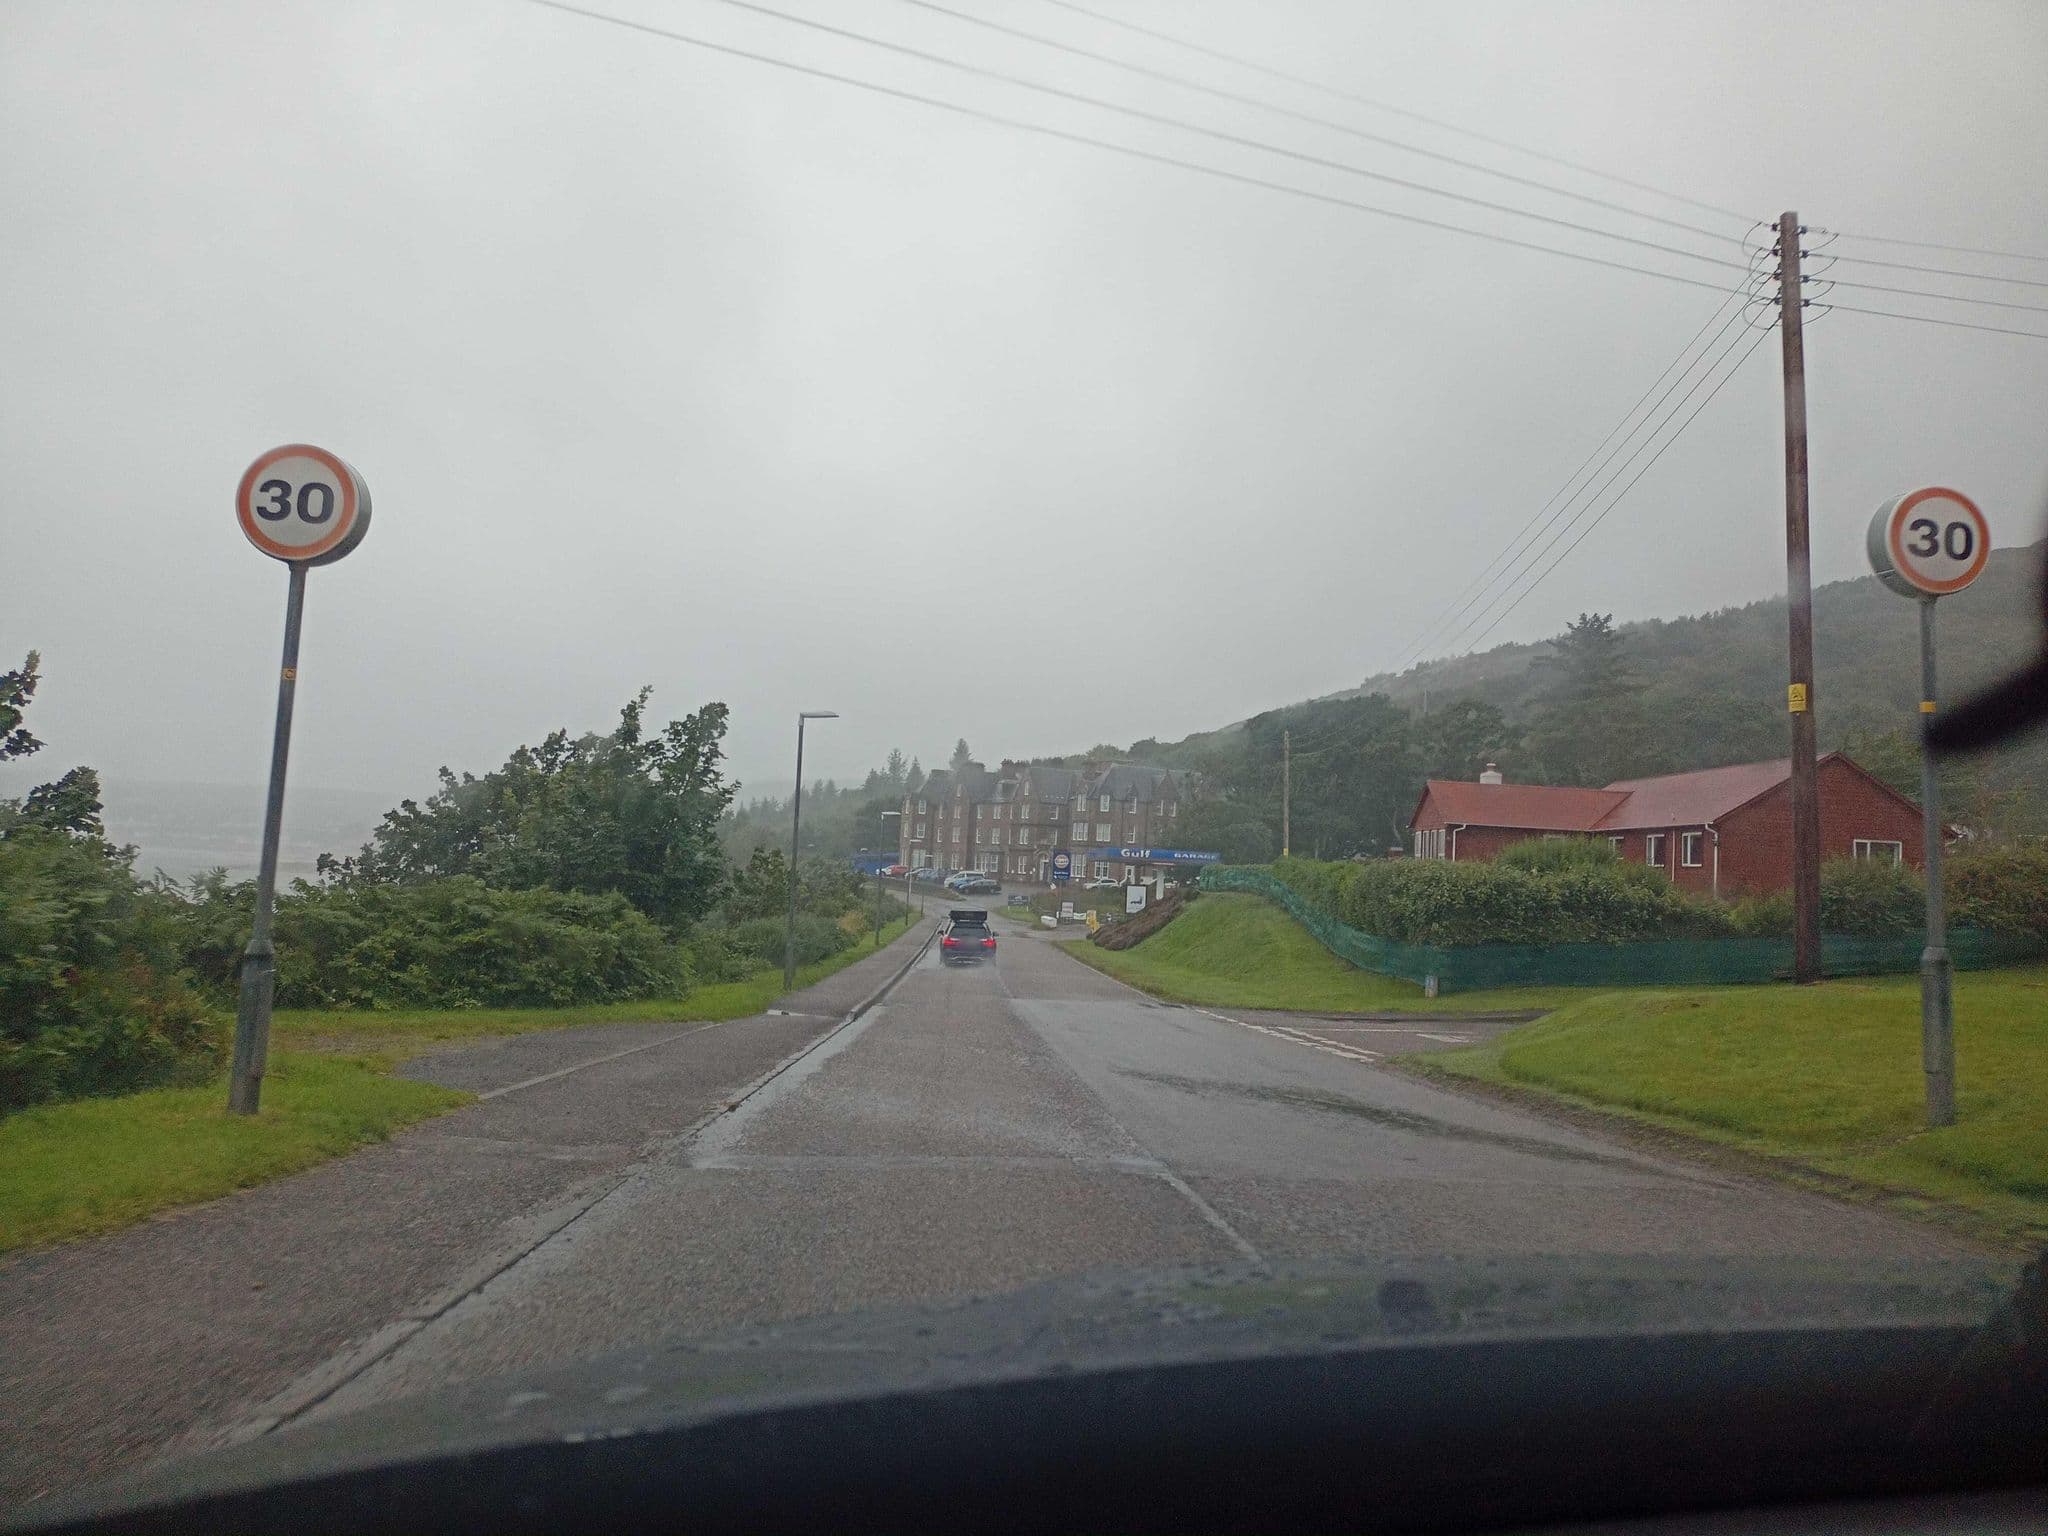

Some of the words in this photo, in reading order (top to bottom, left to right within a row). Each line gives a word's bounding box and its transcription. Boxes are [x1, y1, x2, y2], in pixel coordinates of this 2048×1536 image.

[256, 479, 334, 524] 30
[1907, 518, 1974, 560] 30
[1121, 848, 1151, 858] Gulf
